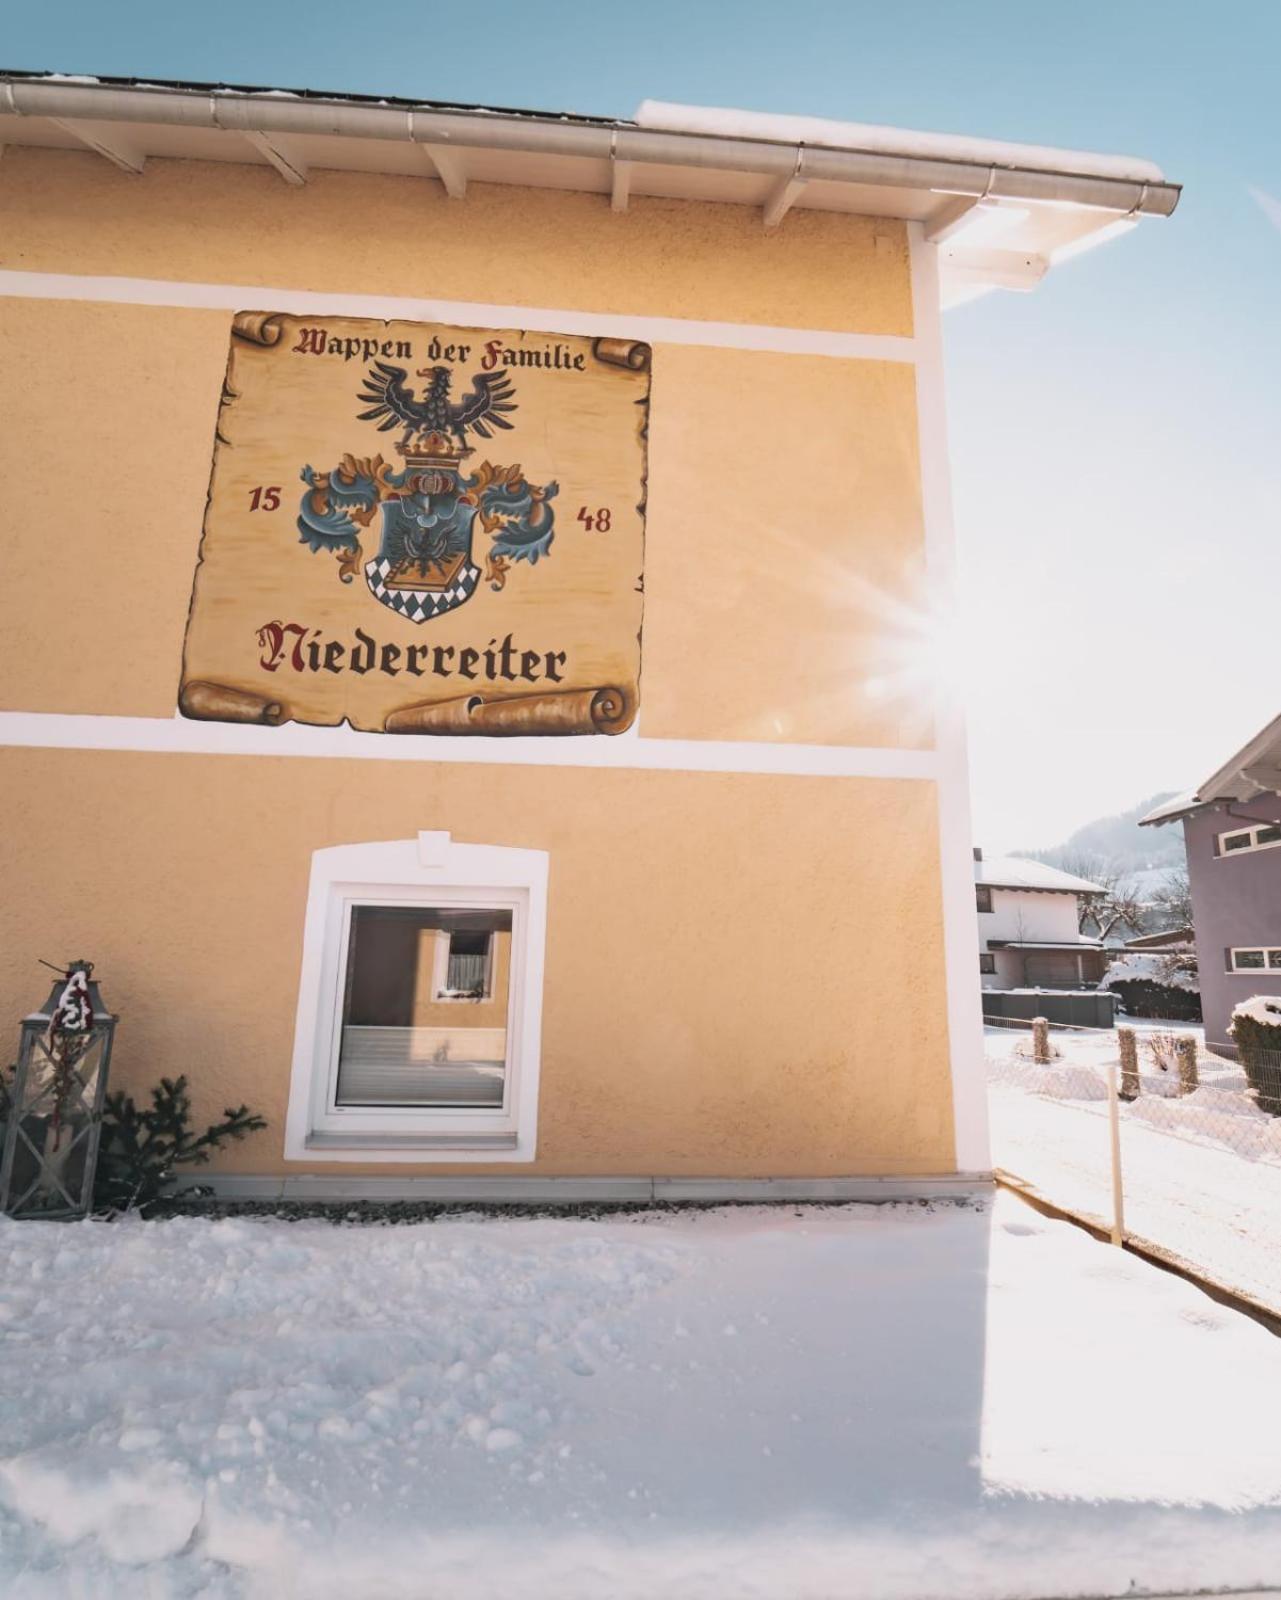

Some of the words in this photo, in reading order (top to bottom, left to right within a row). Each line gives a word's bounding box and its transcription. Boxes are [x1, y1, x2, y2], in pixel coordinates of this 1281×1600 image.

[292, 328, 412, 363] Wappen
[428, 335, 471, 364] der
[480, 339, 586, 372] Familie
[248, 486, 282, 512] 15
[577, 506, 612, 533] 48
[255, 620, 567, 683] Niederreiter
